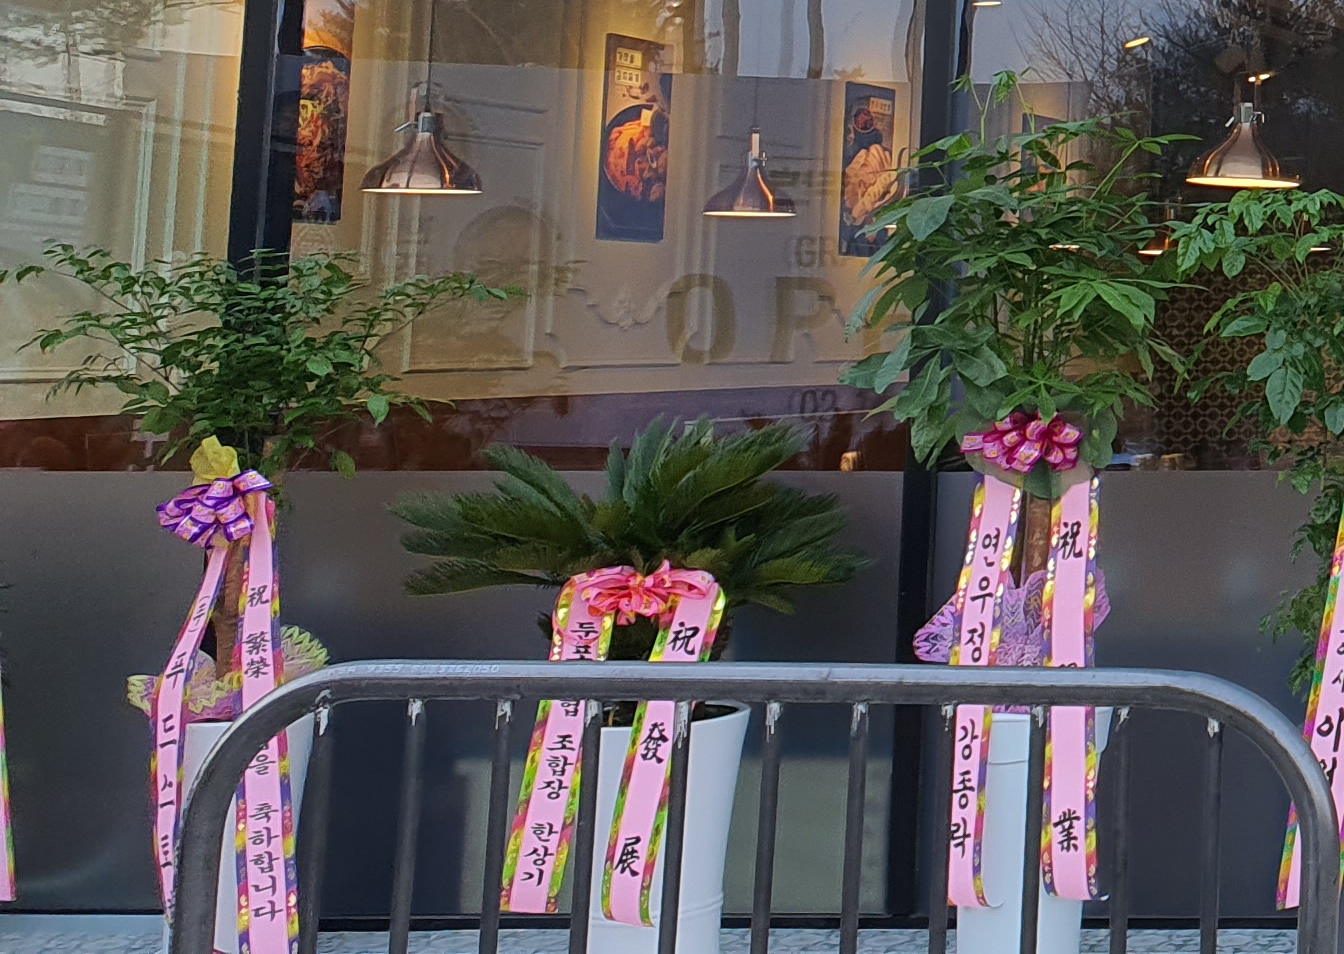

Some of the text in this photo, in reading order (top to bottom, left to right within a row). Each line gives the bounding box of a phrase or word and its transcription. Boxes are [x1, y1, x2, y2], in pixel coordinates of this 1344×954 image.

[964, 527, 1001, 664] 연우정
[537, 734, 577, 800] 조합장
[247, 802, 284, 923] 축하합니다
[520, 821, 560, 887] 한상기
